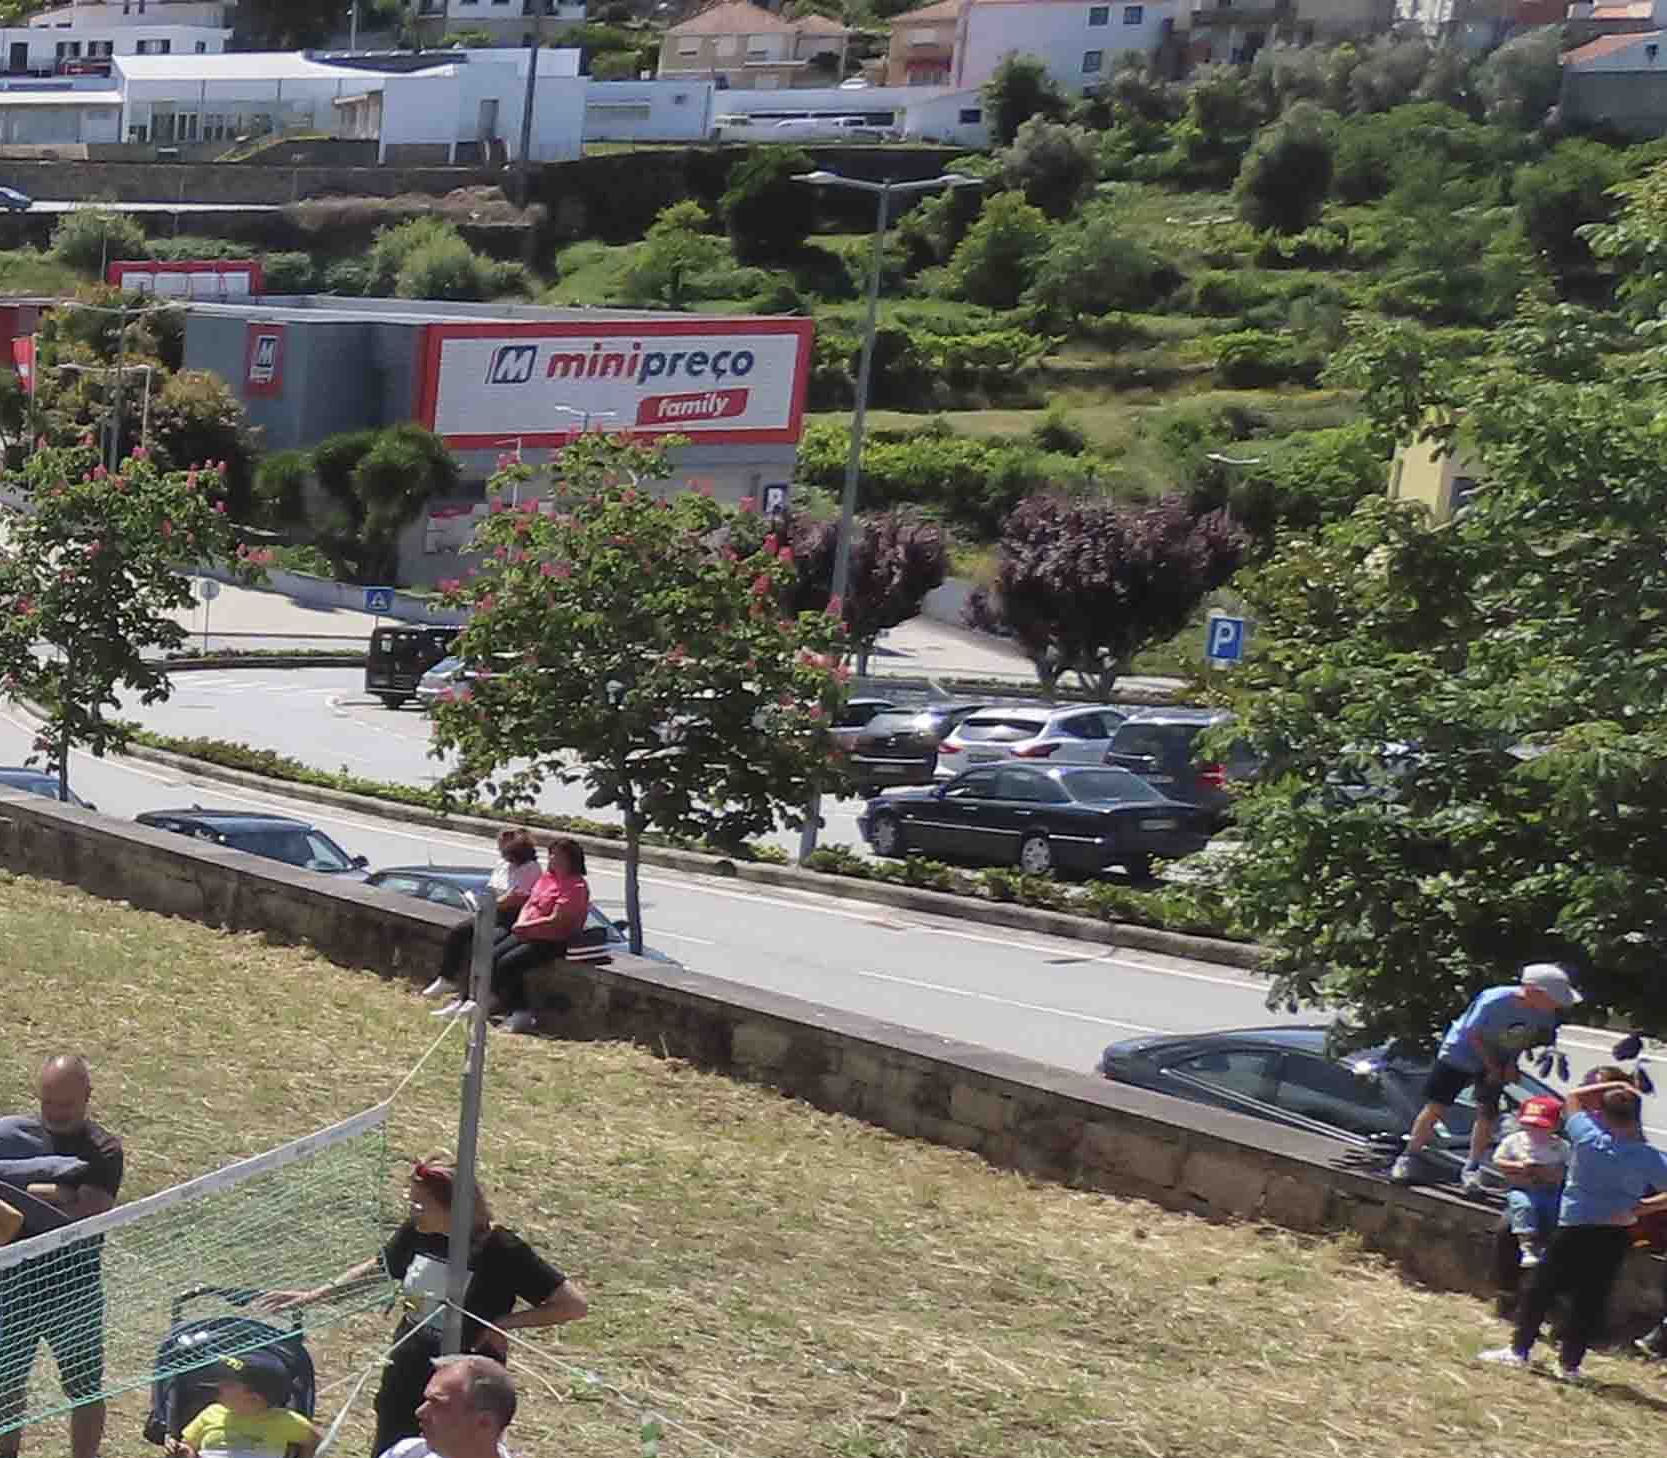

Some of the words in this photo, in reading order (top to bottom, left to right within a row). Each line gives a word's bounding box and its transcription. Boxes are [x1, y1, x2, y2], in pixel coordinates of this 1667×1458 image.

[547, 341, 754, 385] minipreço
[657, 392, 730, 417] family
[1212, 621, 1236, 655] P
